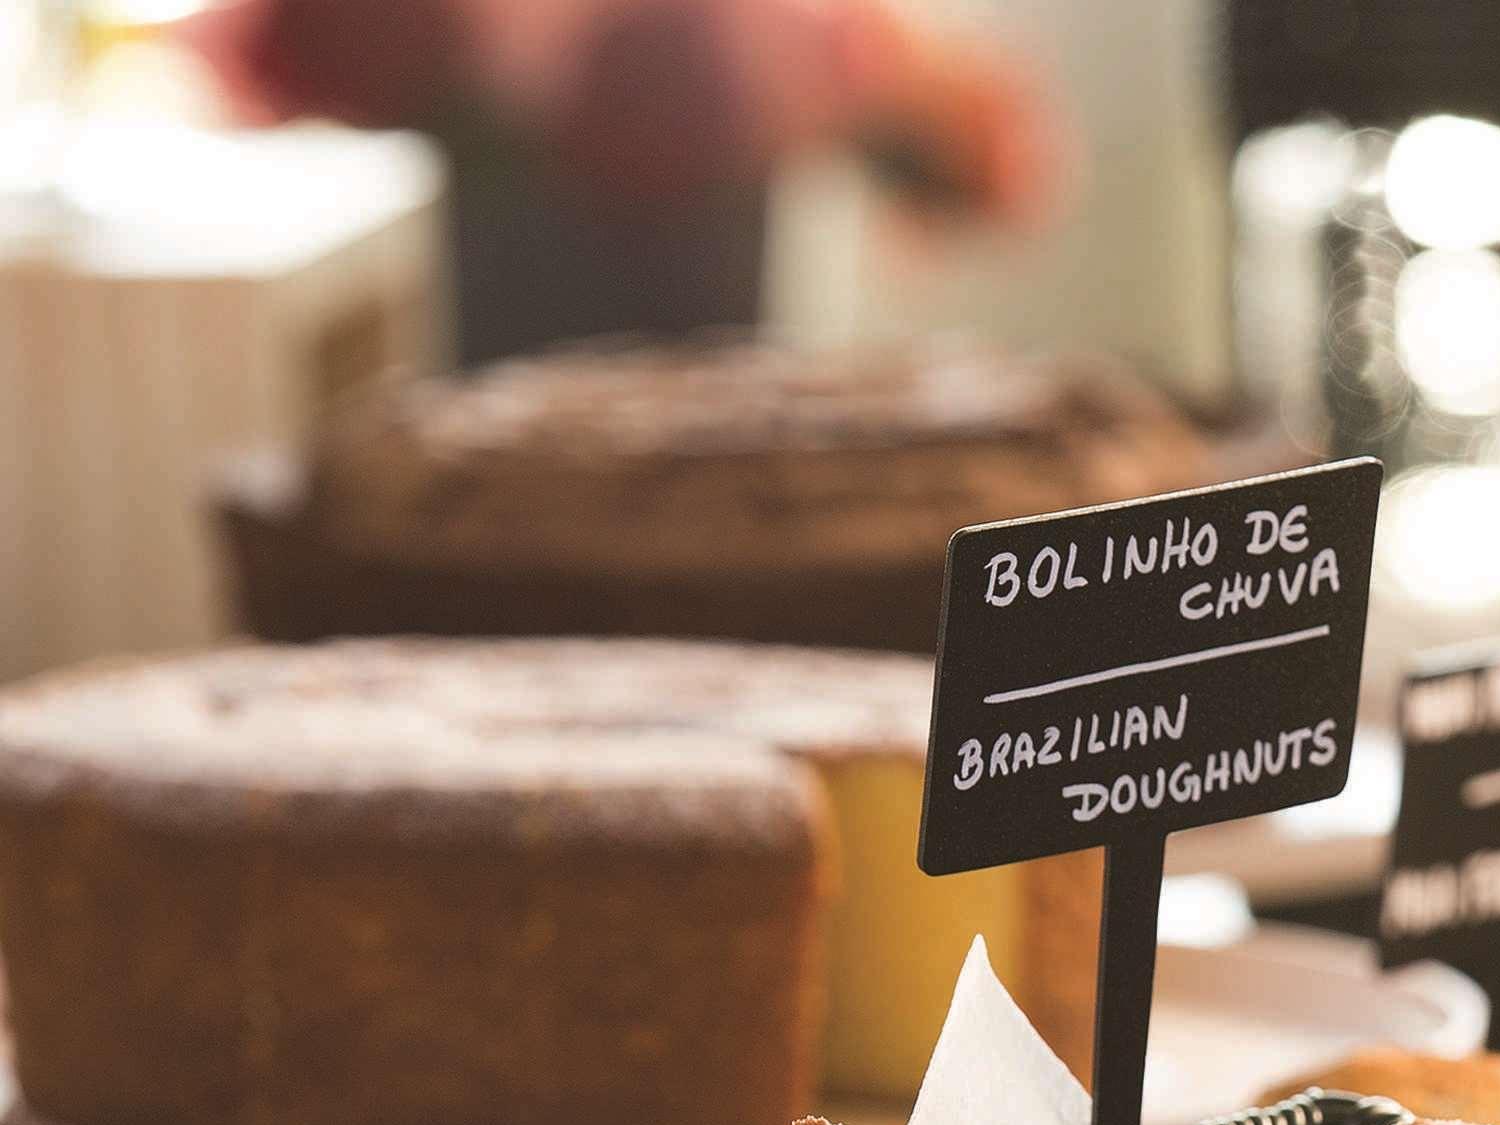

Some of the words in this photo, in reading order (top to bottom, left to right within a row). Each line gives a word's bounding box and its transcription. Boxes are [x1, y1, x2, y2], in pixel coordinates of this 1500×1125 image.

[984, 516, 1218, 607] BOLINHO
[1245, 505, 1310, 555] DE
[1180, 548, 1340, 620] CHUVA
[953, 694, 1189, 790] BRAZILIAN
[1062, 718, 1337, 822] DOUGHNUTS
